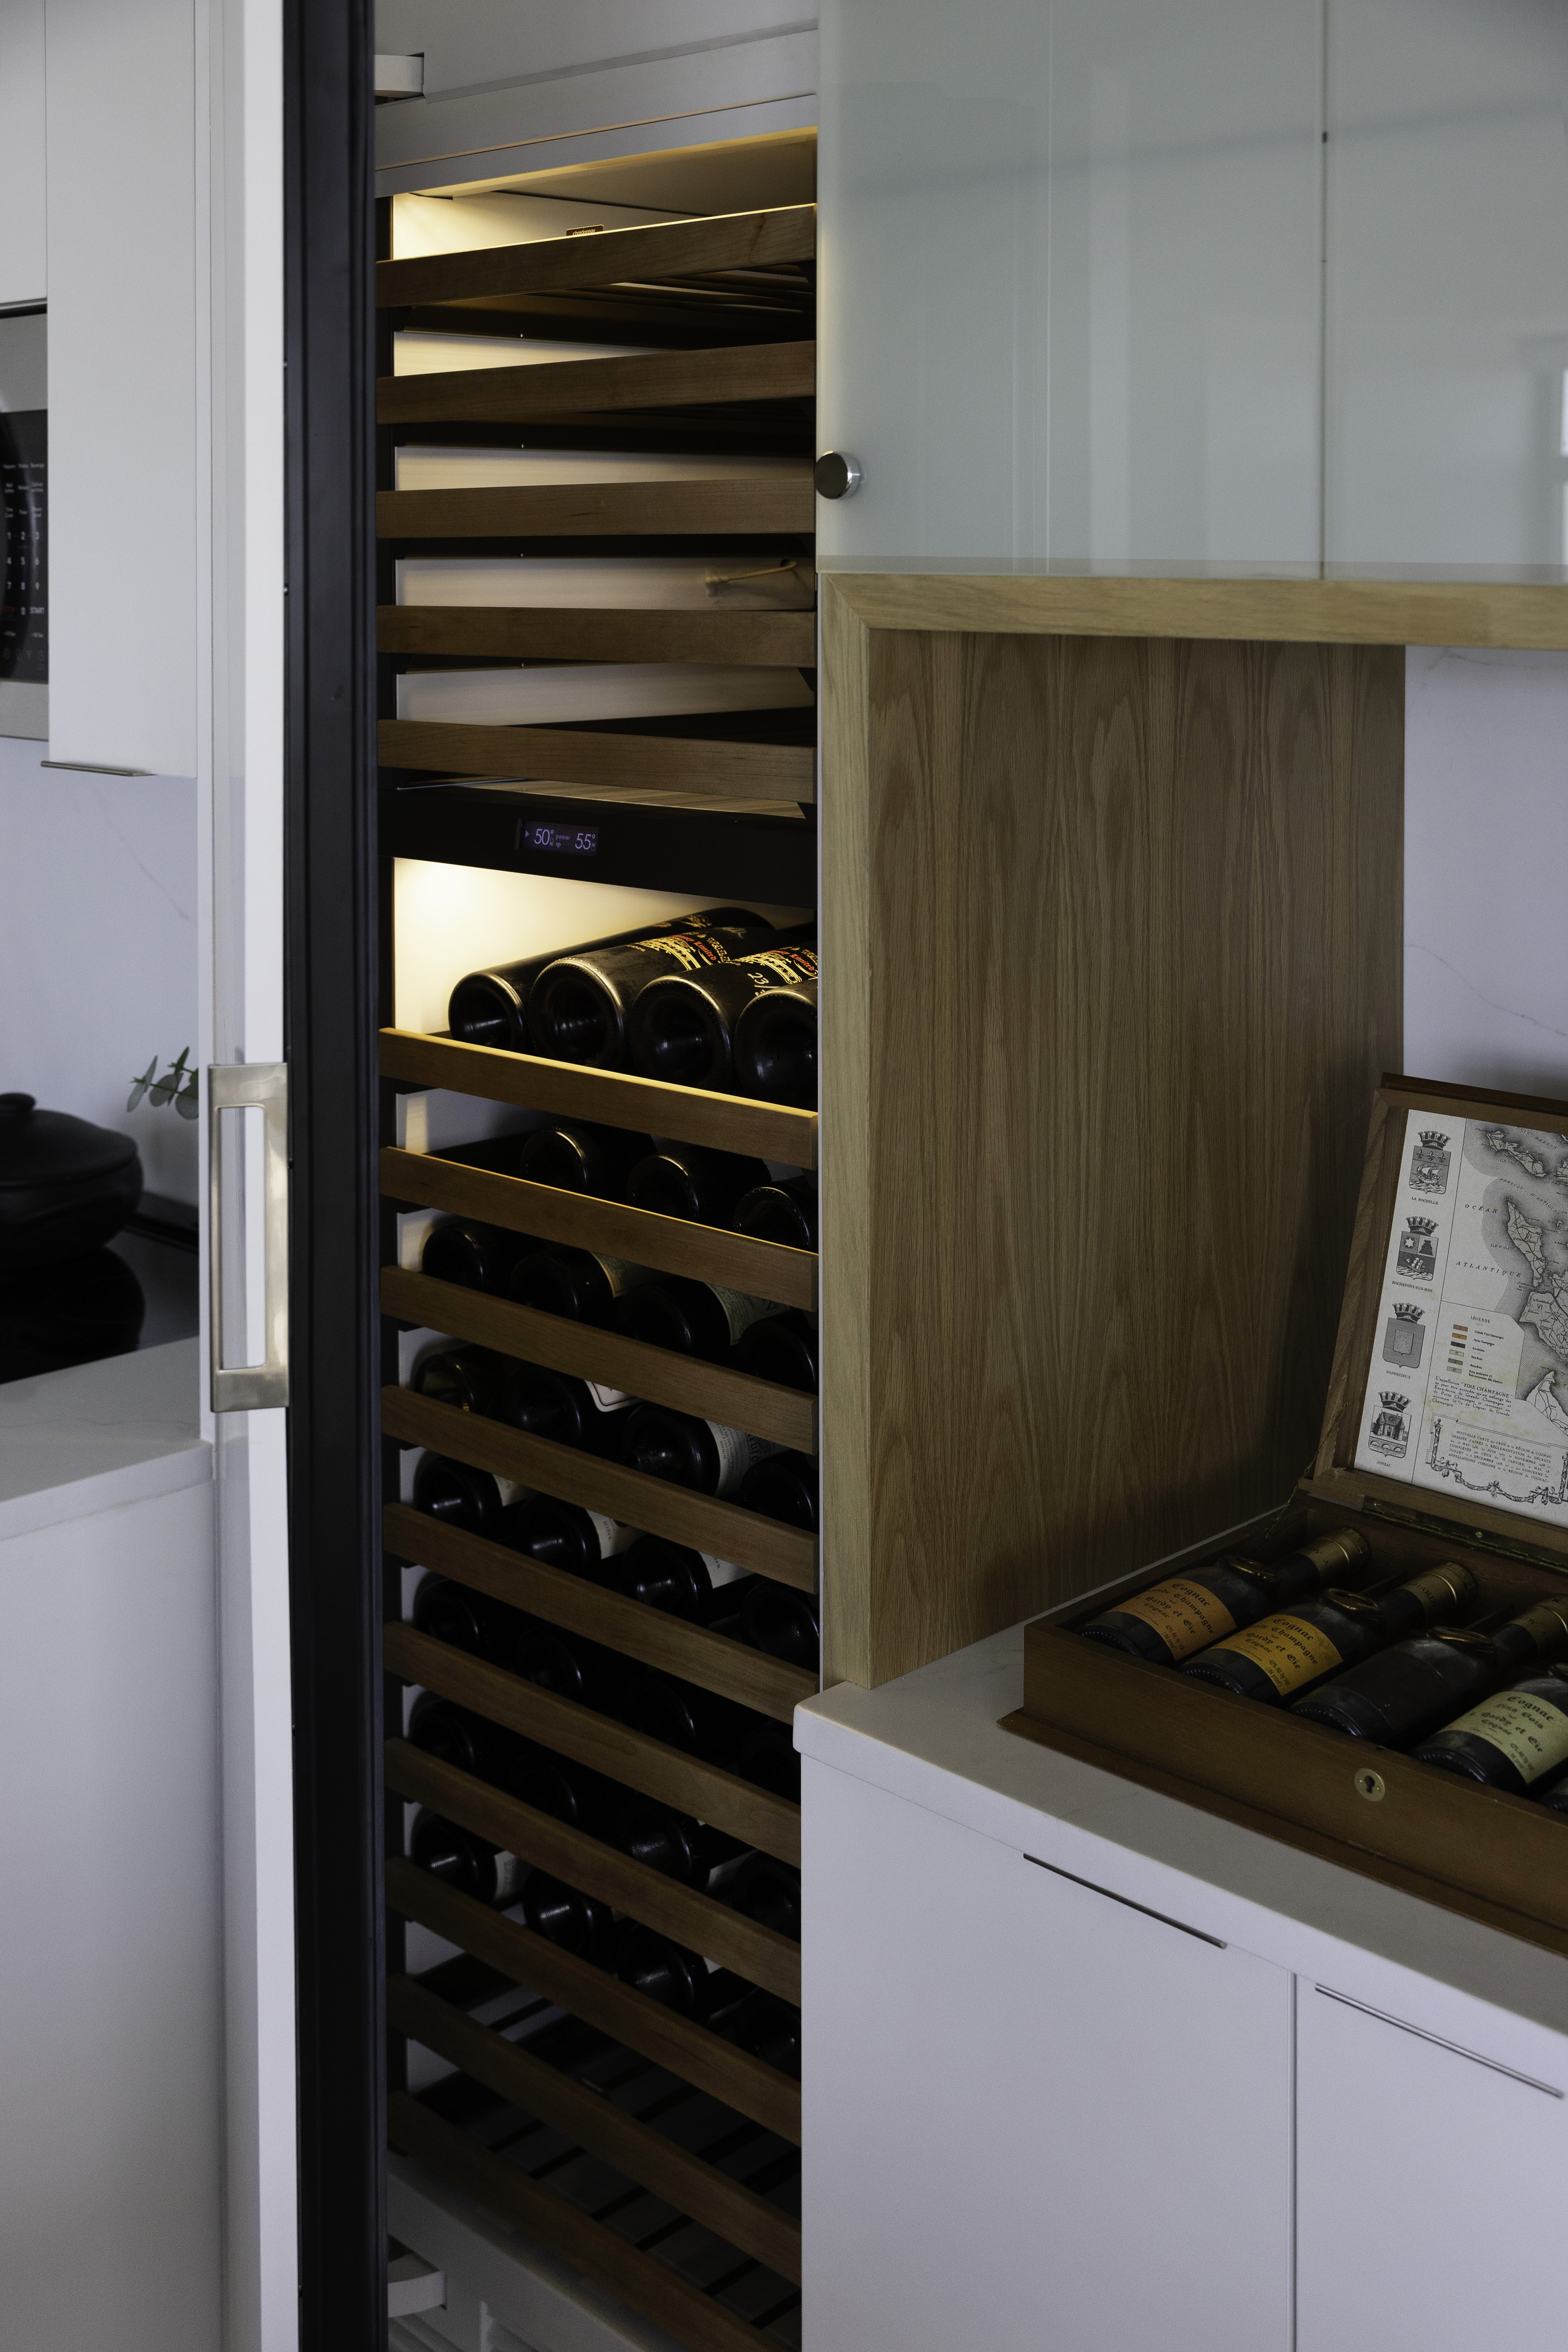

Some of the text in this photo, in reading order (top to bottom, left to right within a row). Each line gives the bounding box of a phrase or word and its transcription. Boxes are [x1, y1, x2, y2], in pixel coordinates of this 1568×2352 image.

[20, 556, 25, 565] 5
[20, 581, 25, 590] 8
[20, 606, 26, 615] 0
[29, 606, 45, 615] START
[534, 829, 554, 845] 50°
[575, 833, 595, 850] 55°
[693, 941, 716, 960] Limited
[789, 953, 815, 971] Limited
[1465, 1204, 1498, 1213] OCÉAN
[1456, 1261, 1521, 1278] ATLANTIQUE
[1392, 1281, 1433, 1293] ROCHEFORT-SUR-MER
[1470, 1314, 1490, 1323] LÉGENDE
[1436, 1376, 1459, 1387] L'appellation
[1432, 1397, 1453, 1408] Champagne
[1434, 1384, 1455, 1394] Eaux-de-vie
[1482, 1397, 1503, 1407] Champagne
[1454, 1394, 1475, 1404] Champagne
[1488, 1394, 1503, 1402] mélange
[1472, 1403, 1486, 1411] Cognac
[1456, 1430, 1476, 1439] NOUVELLE
[1450, 1443, 1471, 1452] COMPLÉTÉE
[1448, 1452, 1475, 1463] APPELLATIONS
[1474, 1454, 1494, 1463] DÉCEMBRE
[1522, 1467, 1543, 1475] CONCERNE
[1514, 1455, 1535, 1464] NOVEMBRE
[1172, 1584, 1210, 1606] Cognac
[1413, 1583, 1437, 1607] HARDY
[1144, 1603, 1169, 1618] Cognac
[1146, 1597, 1171, 1610] Hardy
[1183, 1620, 1196, 1634] Cie
[1174, 1593, 1215, 1635] Champagne
[1273, 1619, 1314, 1640] Cognac
[1245, 1639, 1272, 1653] Cognac
[1247, 1633, 1274, 1645] Hardy
[1287, 1654, 1301, 1669] Cie
[1271, 1627, 1318, 1664] Champagne
[1507, 1696, 1553, 1720] Cognac
[1481, 1712, 1512, 1726] Hardy
[1521, 1712, 1543, 1729] Bois
[1481, 1719, 1512, 1735] Cognac
